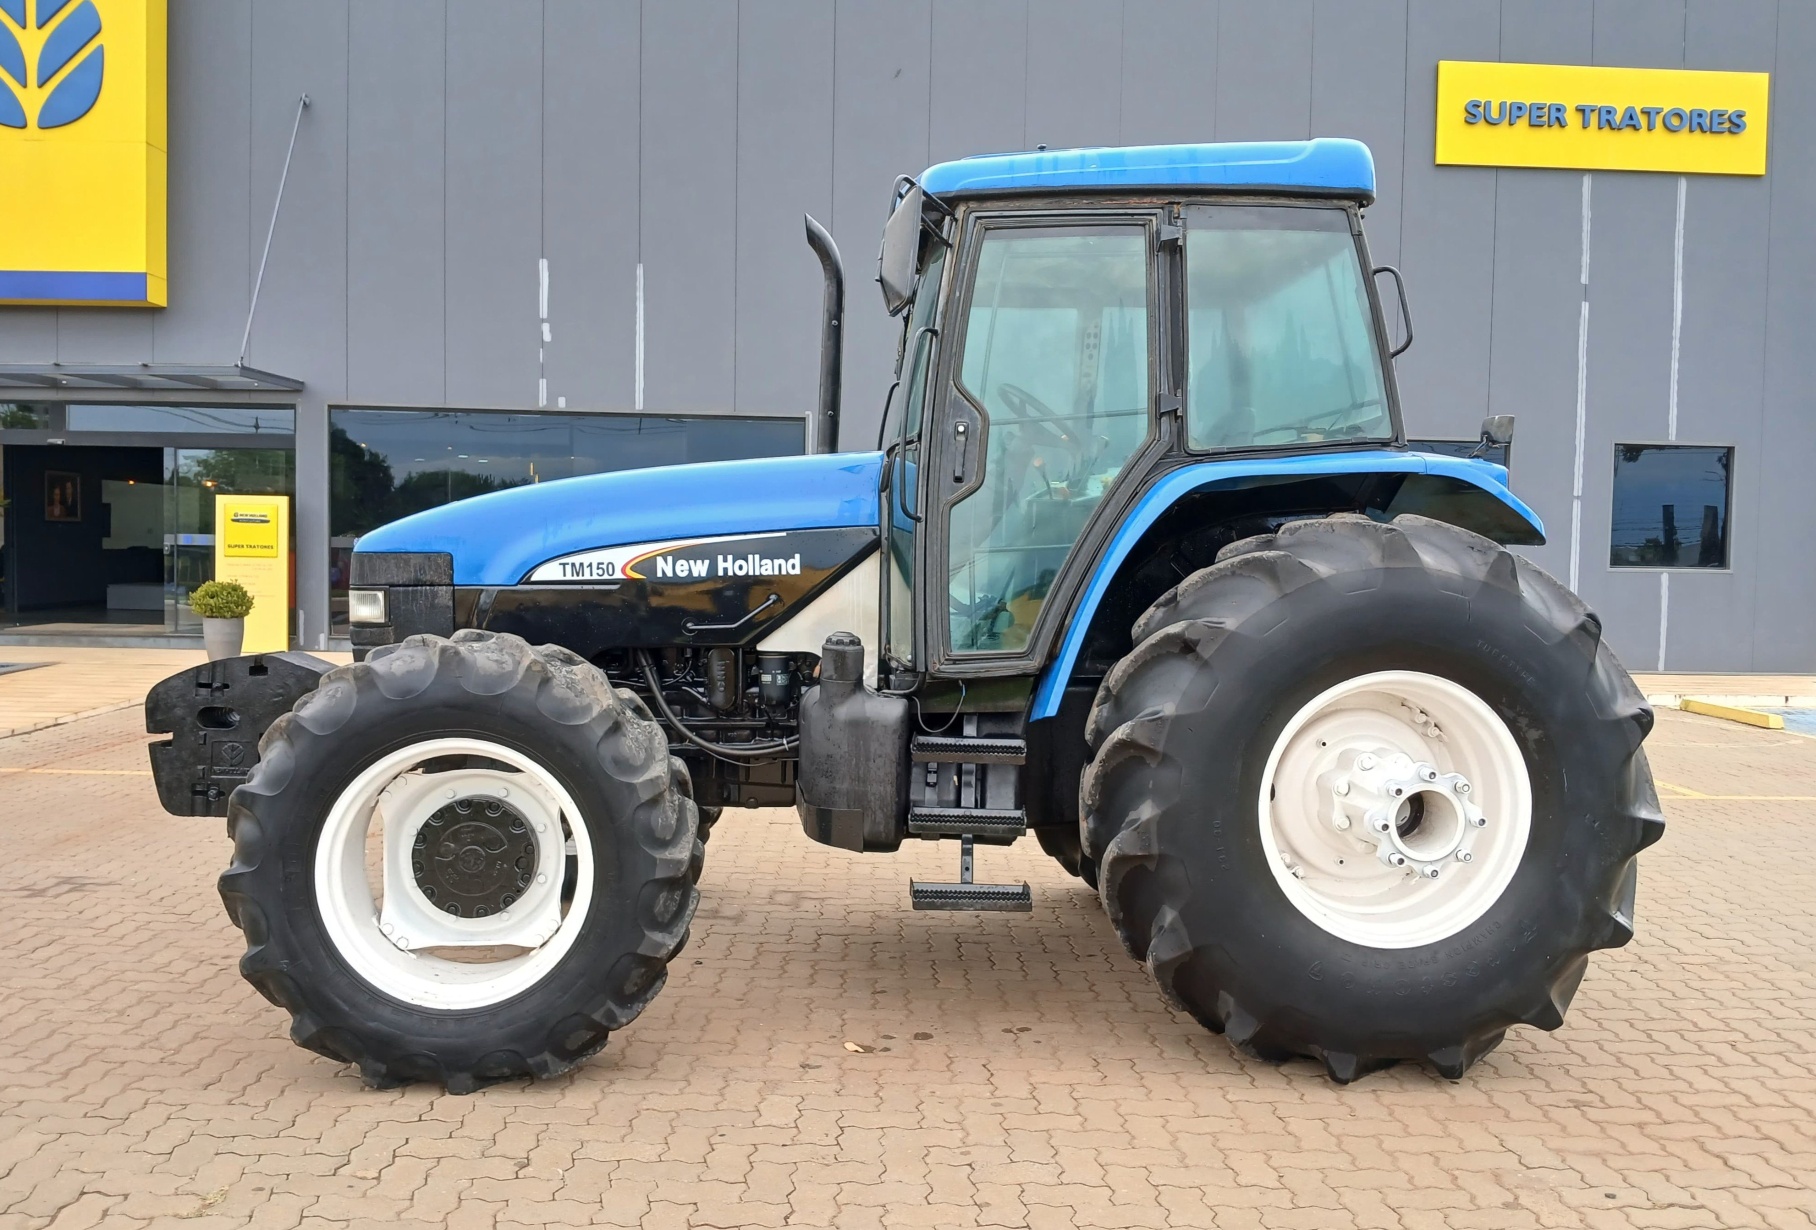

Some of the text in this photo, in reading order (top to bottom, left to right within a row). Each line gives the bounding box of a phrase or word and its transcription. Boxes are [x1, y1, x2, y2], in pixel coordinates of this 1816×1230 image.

[1464, 99, 1748, 134] SUPER TRATORES
[559, 561, 615, 578] TM150
[656, 553, 801, 577] New Holland
